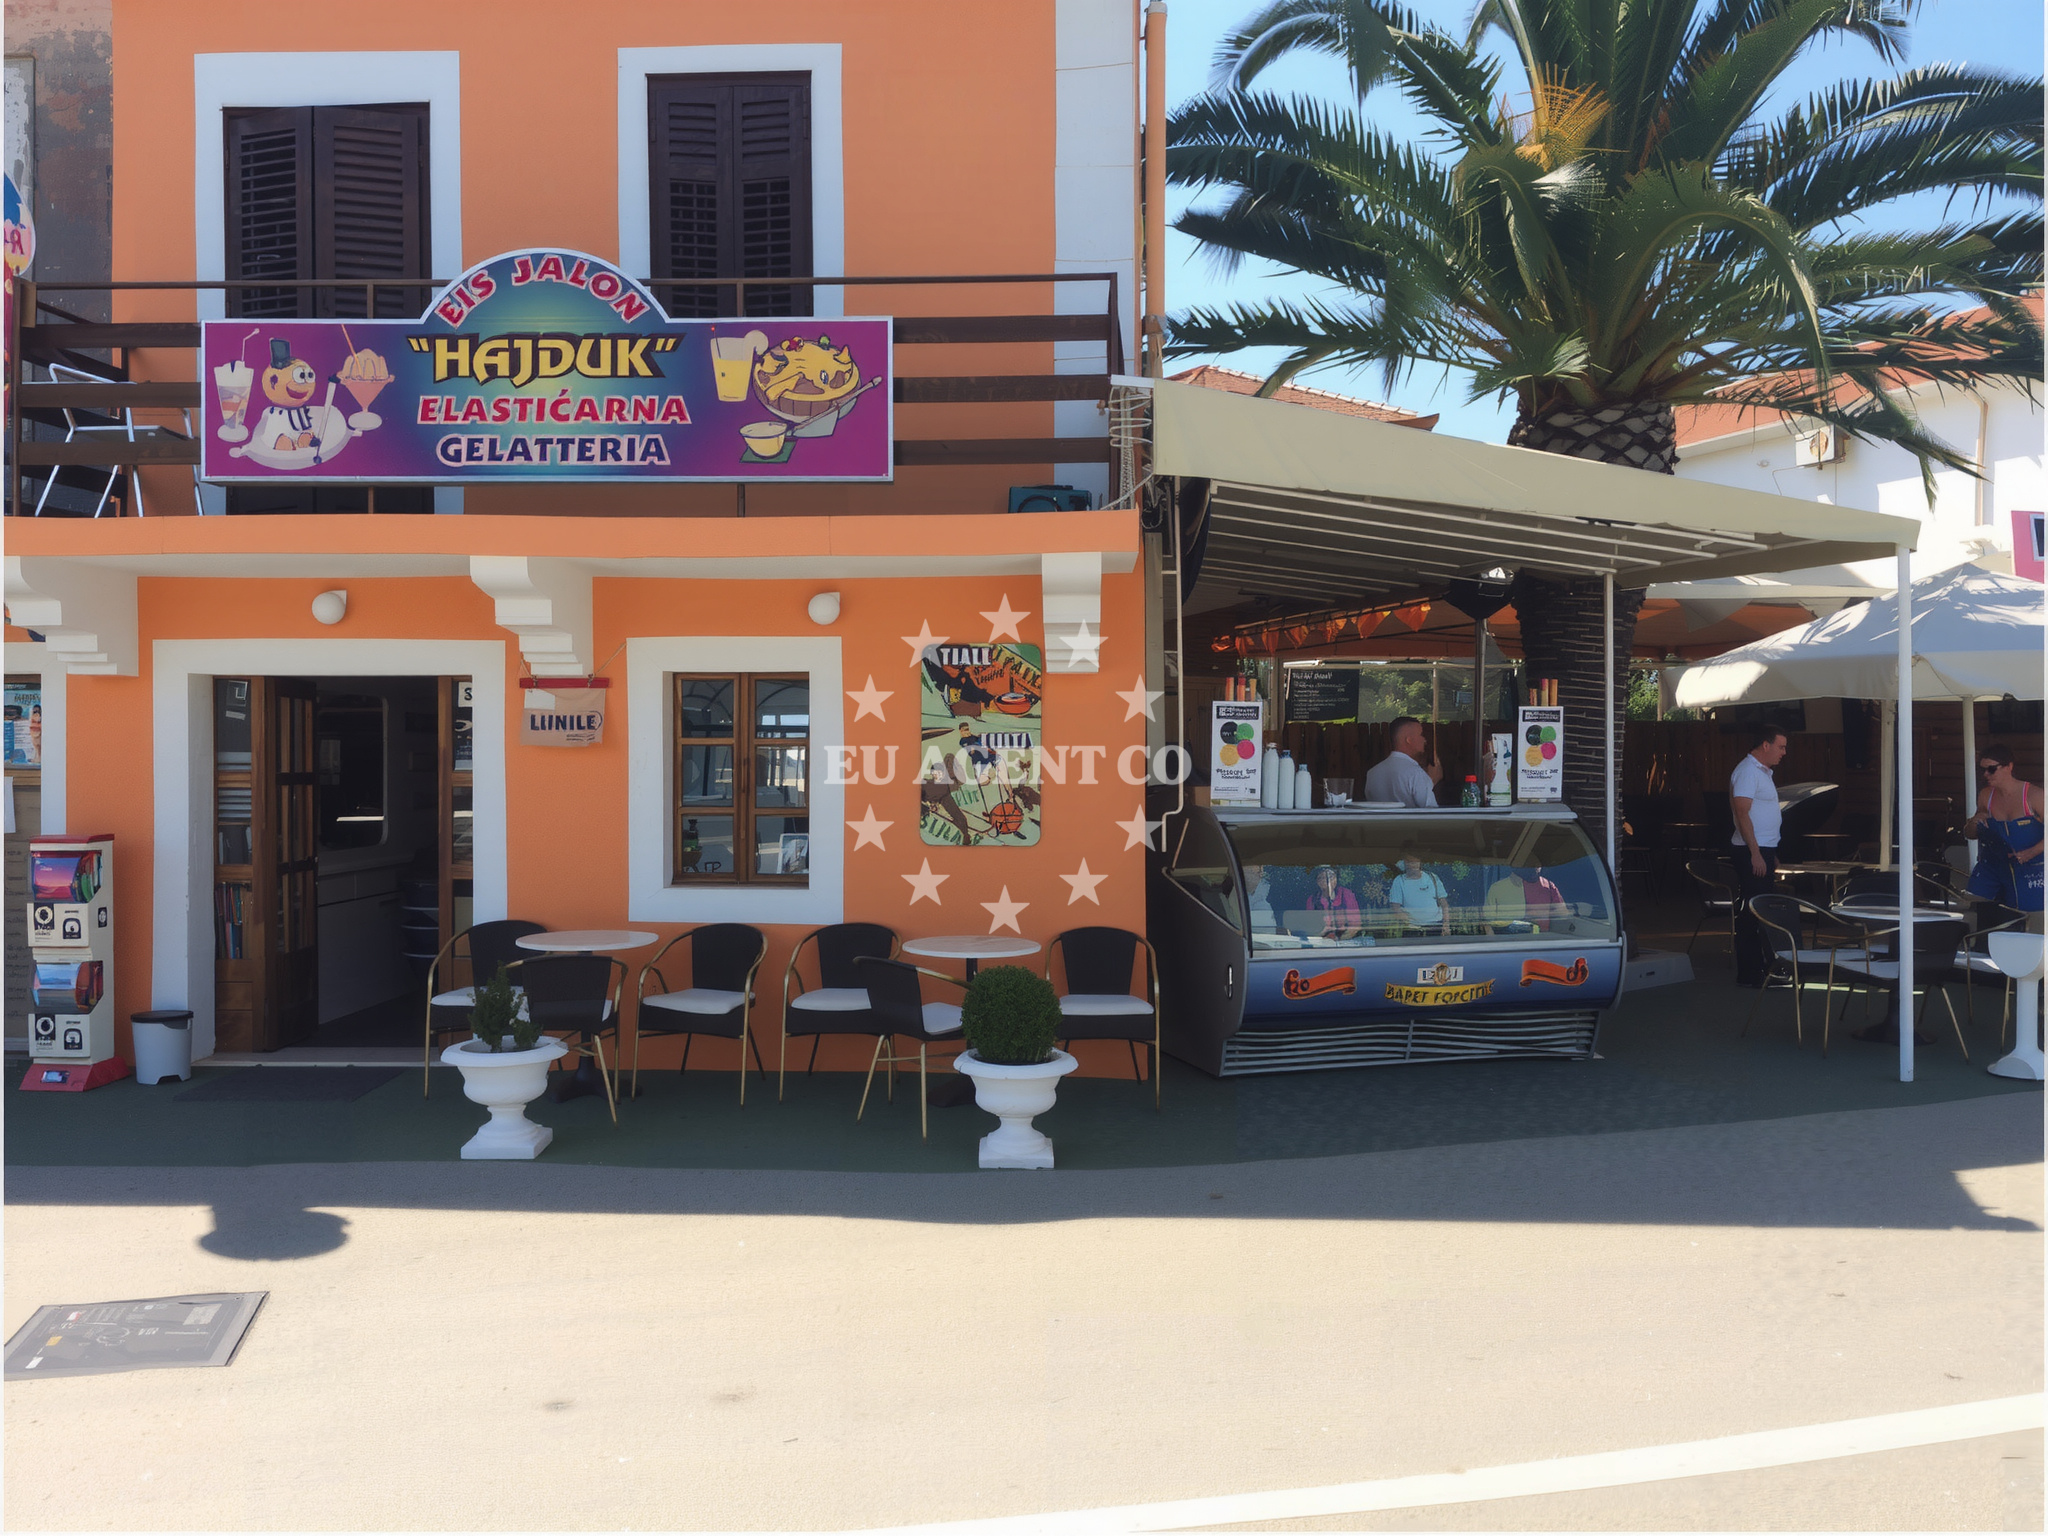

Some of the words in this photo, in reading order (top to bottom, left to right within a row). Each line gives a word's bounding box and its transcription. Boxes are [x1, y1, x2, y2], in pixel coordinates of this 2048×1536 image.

[435, 269, 496, 328] EIS
[512, 254, 650, 323] JALON
[417, 388, 692, 424] ELASTIĆARNA
[437, 434, 670, 467] GELATTERIA
